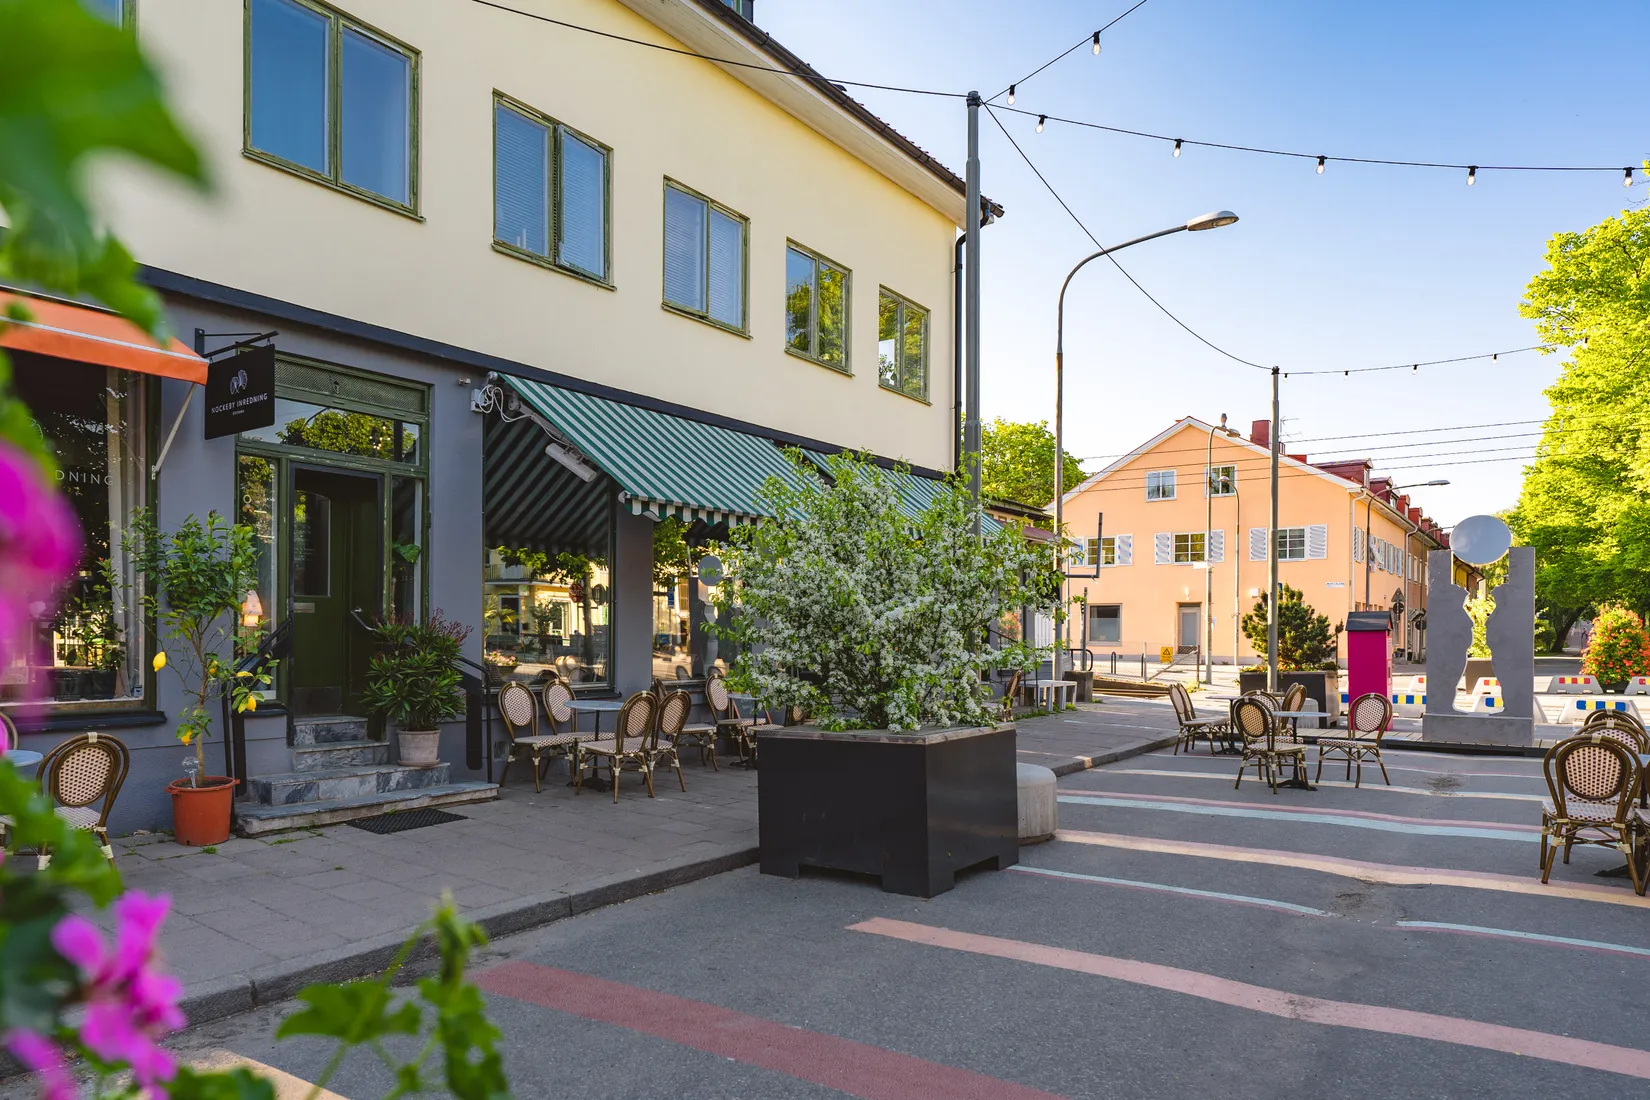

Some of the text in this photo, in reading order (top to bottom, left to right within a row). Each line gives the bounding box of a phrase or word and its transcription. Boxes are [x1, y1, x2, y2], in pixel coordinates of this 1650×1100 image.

[211, 401, 236, 414] NOCKEBY
[236, 393, 268, 408] INREDNING
[55, 469, 114, 486] DNING
